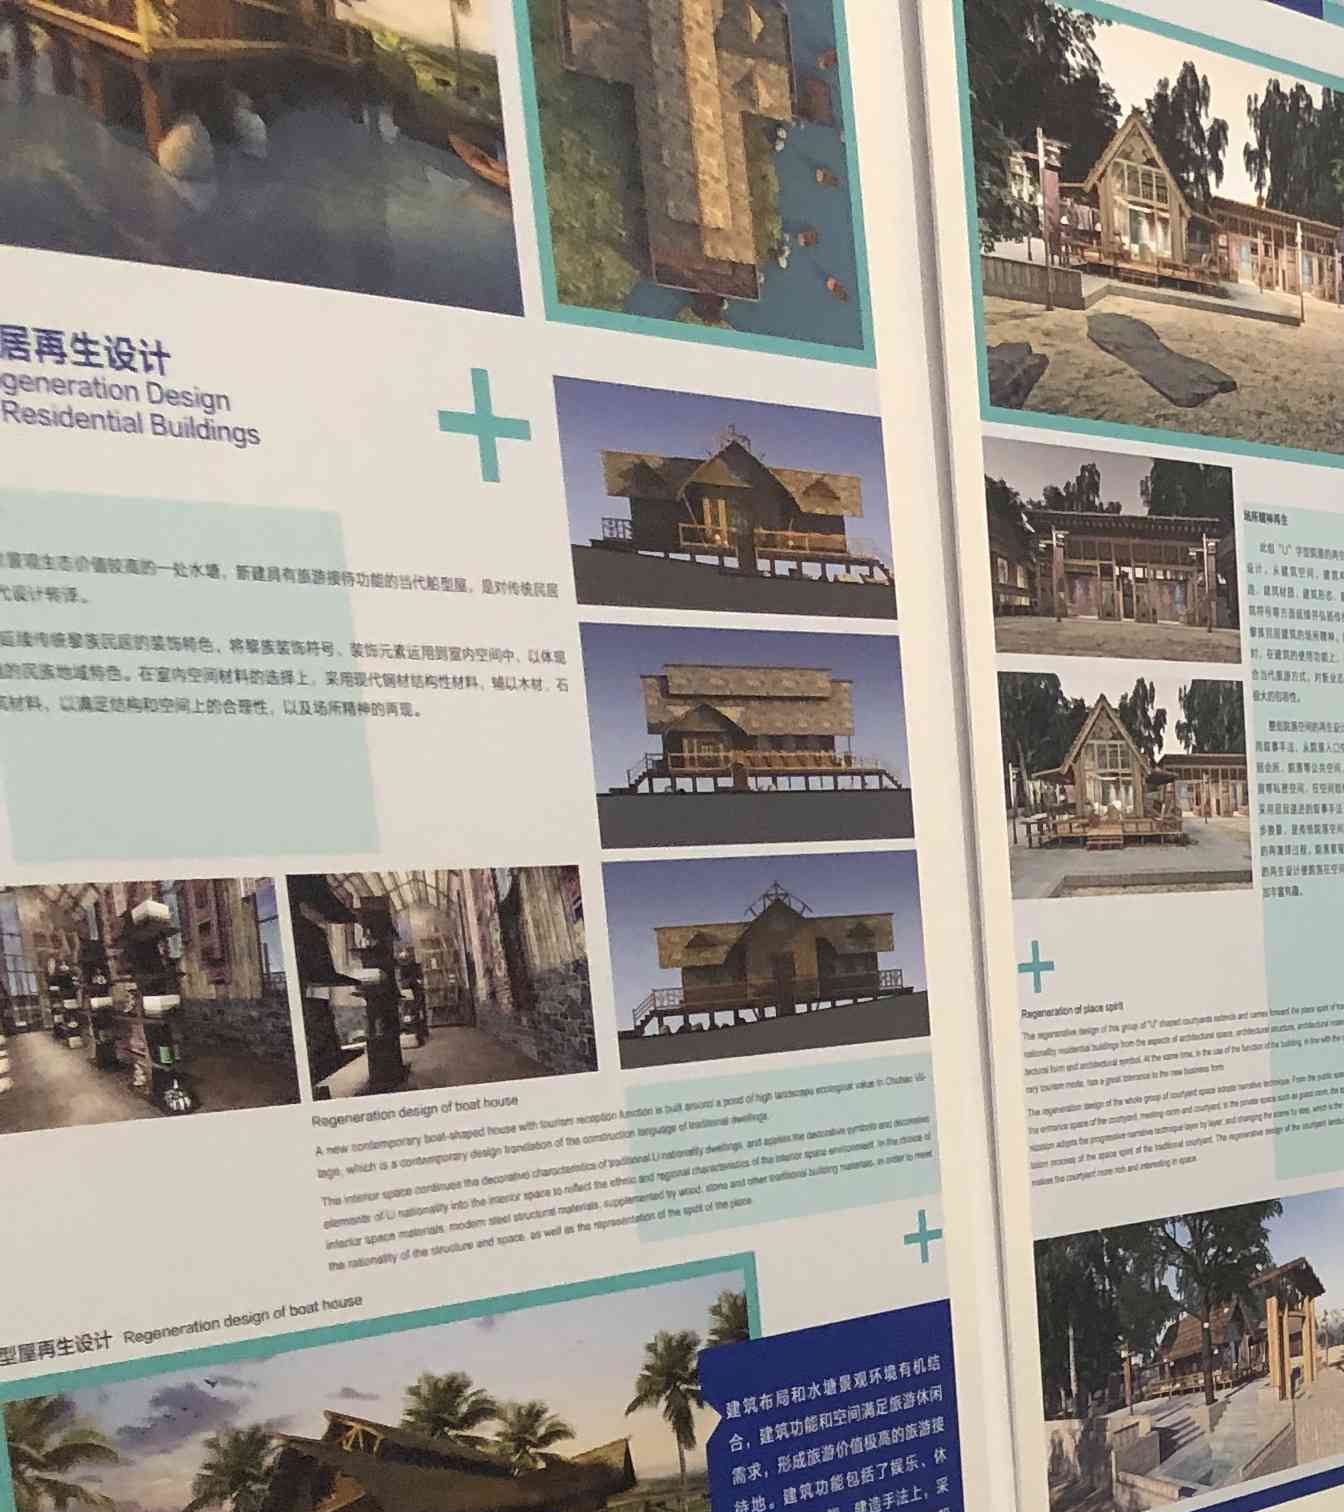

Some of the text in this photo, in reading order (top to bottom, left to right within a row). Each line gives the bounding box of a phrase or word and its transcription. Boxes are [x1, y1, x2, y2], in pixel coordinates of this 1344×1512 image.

[0, 324, 172, 377] 居再生设计
[147, 381, 231, 413] Design
[2, 399, 261, 448] Residential Buildings
[1021, 1006, 1073, 1021] Regeneration
[311, 1094, 519, 1128] Regeneration design of boat house
[0, 1295, 363, 1367] 型屋再生设计 Regeneration design of boat house
[726, 1354, 941, 1420] 建筑布局和水塘景观环境有机结
